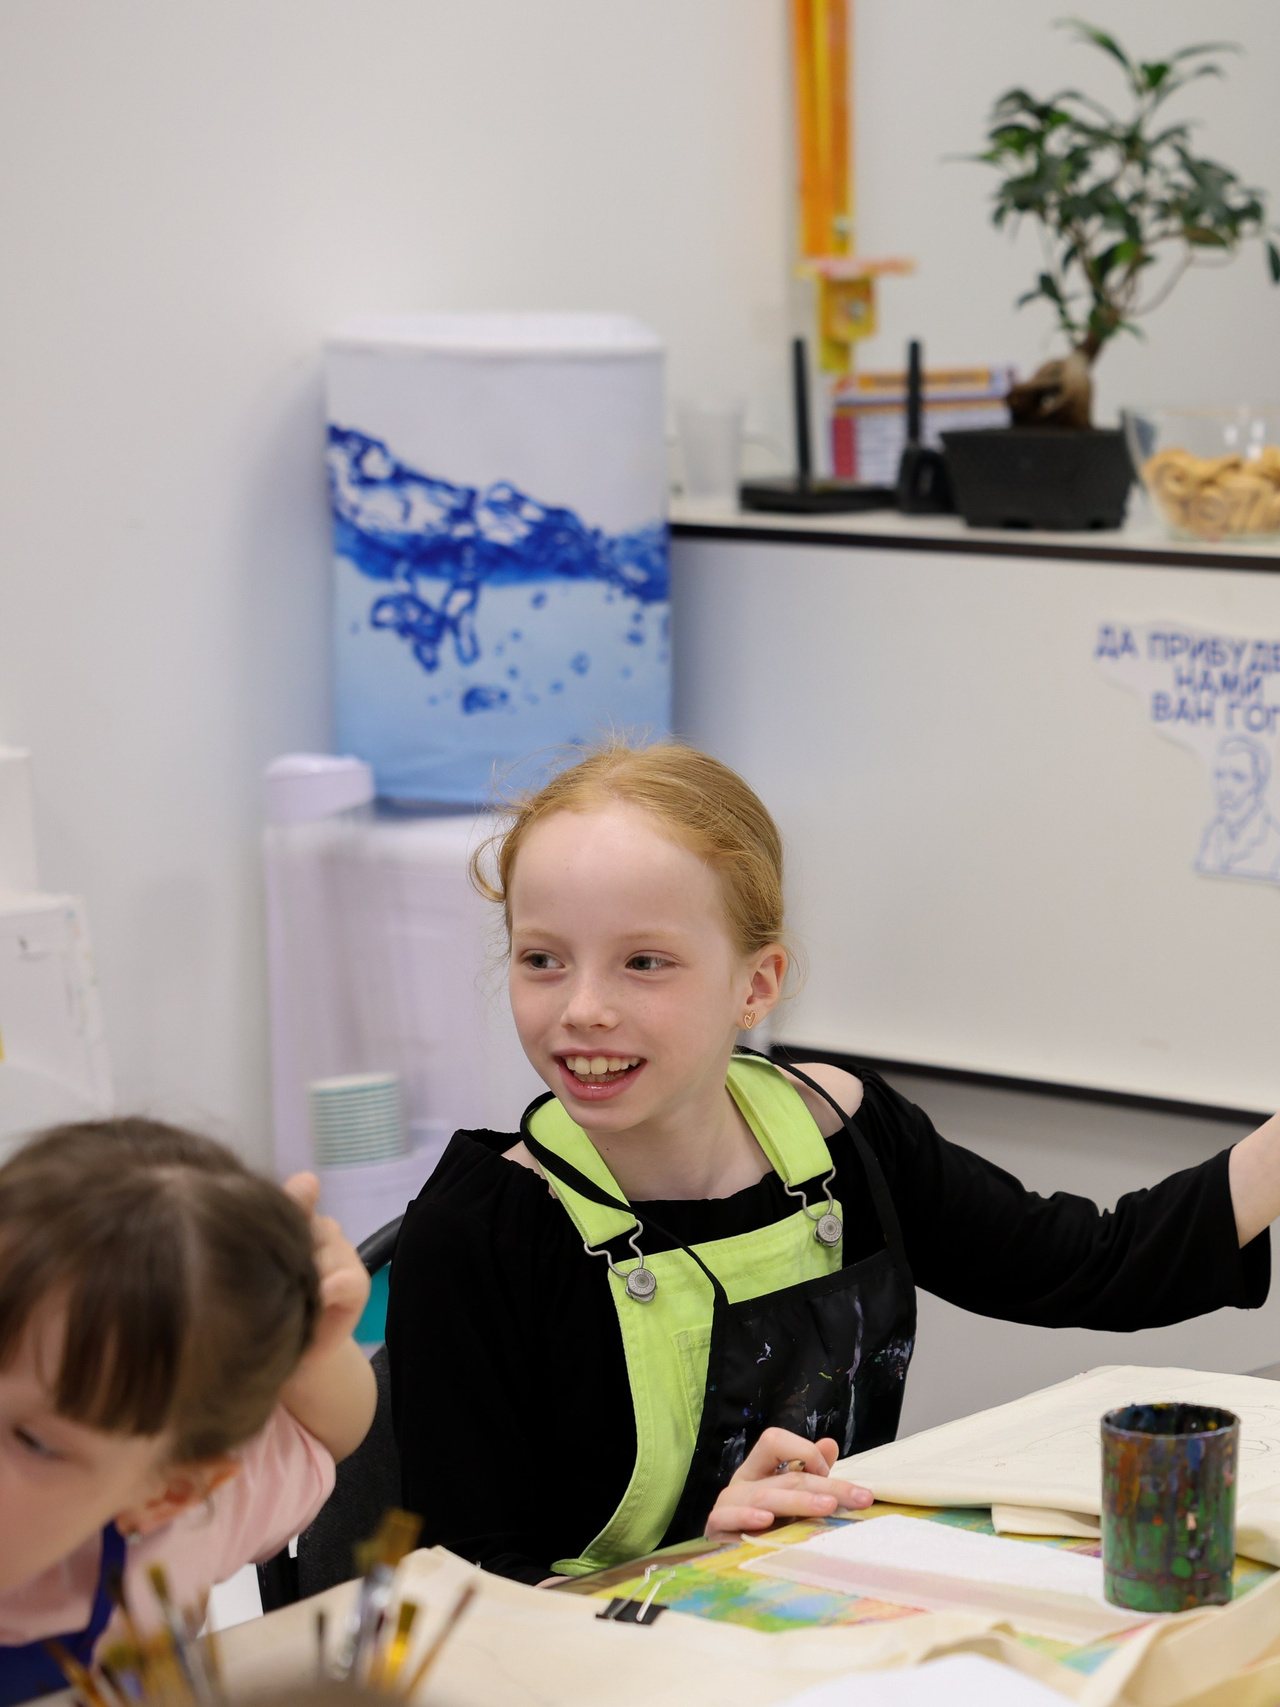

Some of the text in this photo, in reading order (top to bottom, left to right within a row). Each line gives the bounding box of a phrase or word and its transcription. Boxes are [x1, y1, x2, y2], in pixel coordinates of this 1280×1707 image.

[1094, 624, 1138, 660] ДА
[1175, 664, 1263, 704] НАМИ
[1151, 690, 1215, 728] ВАН
